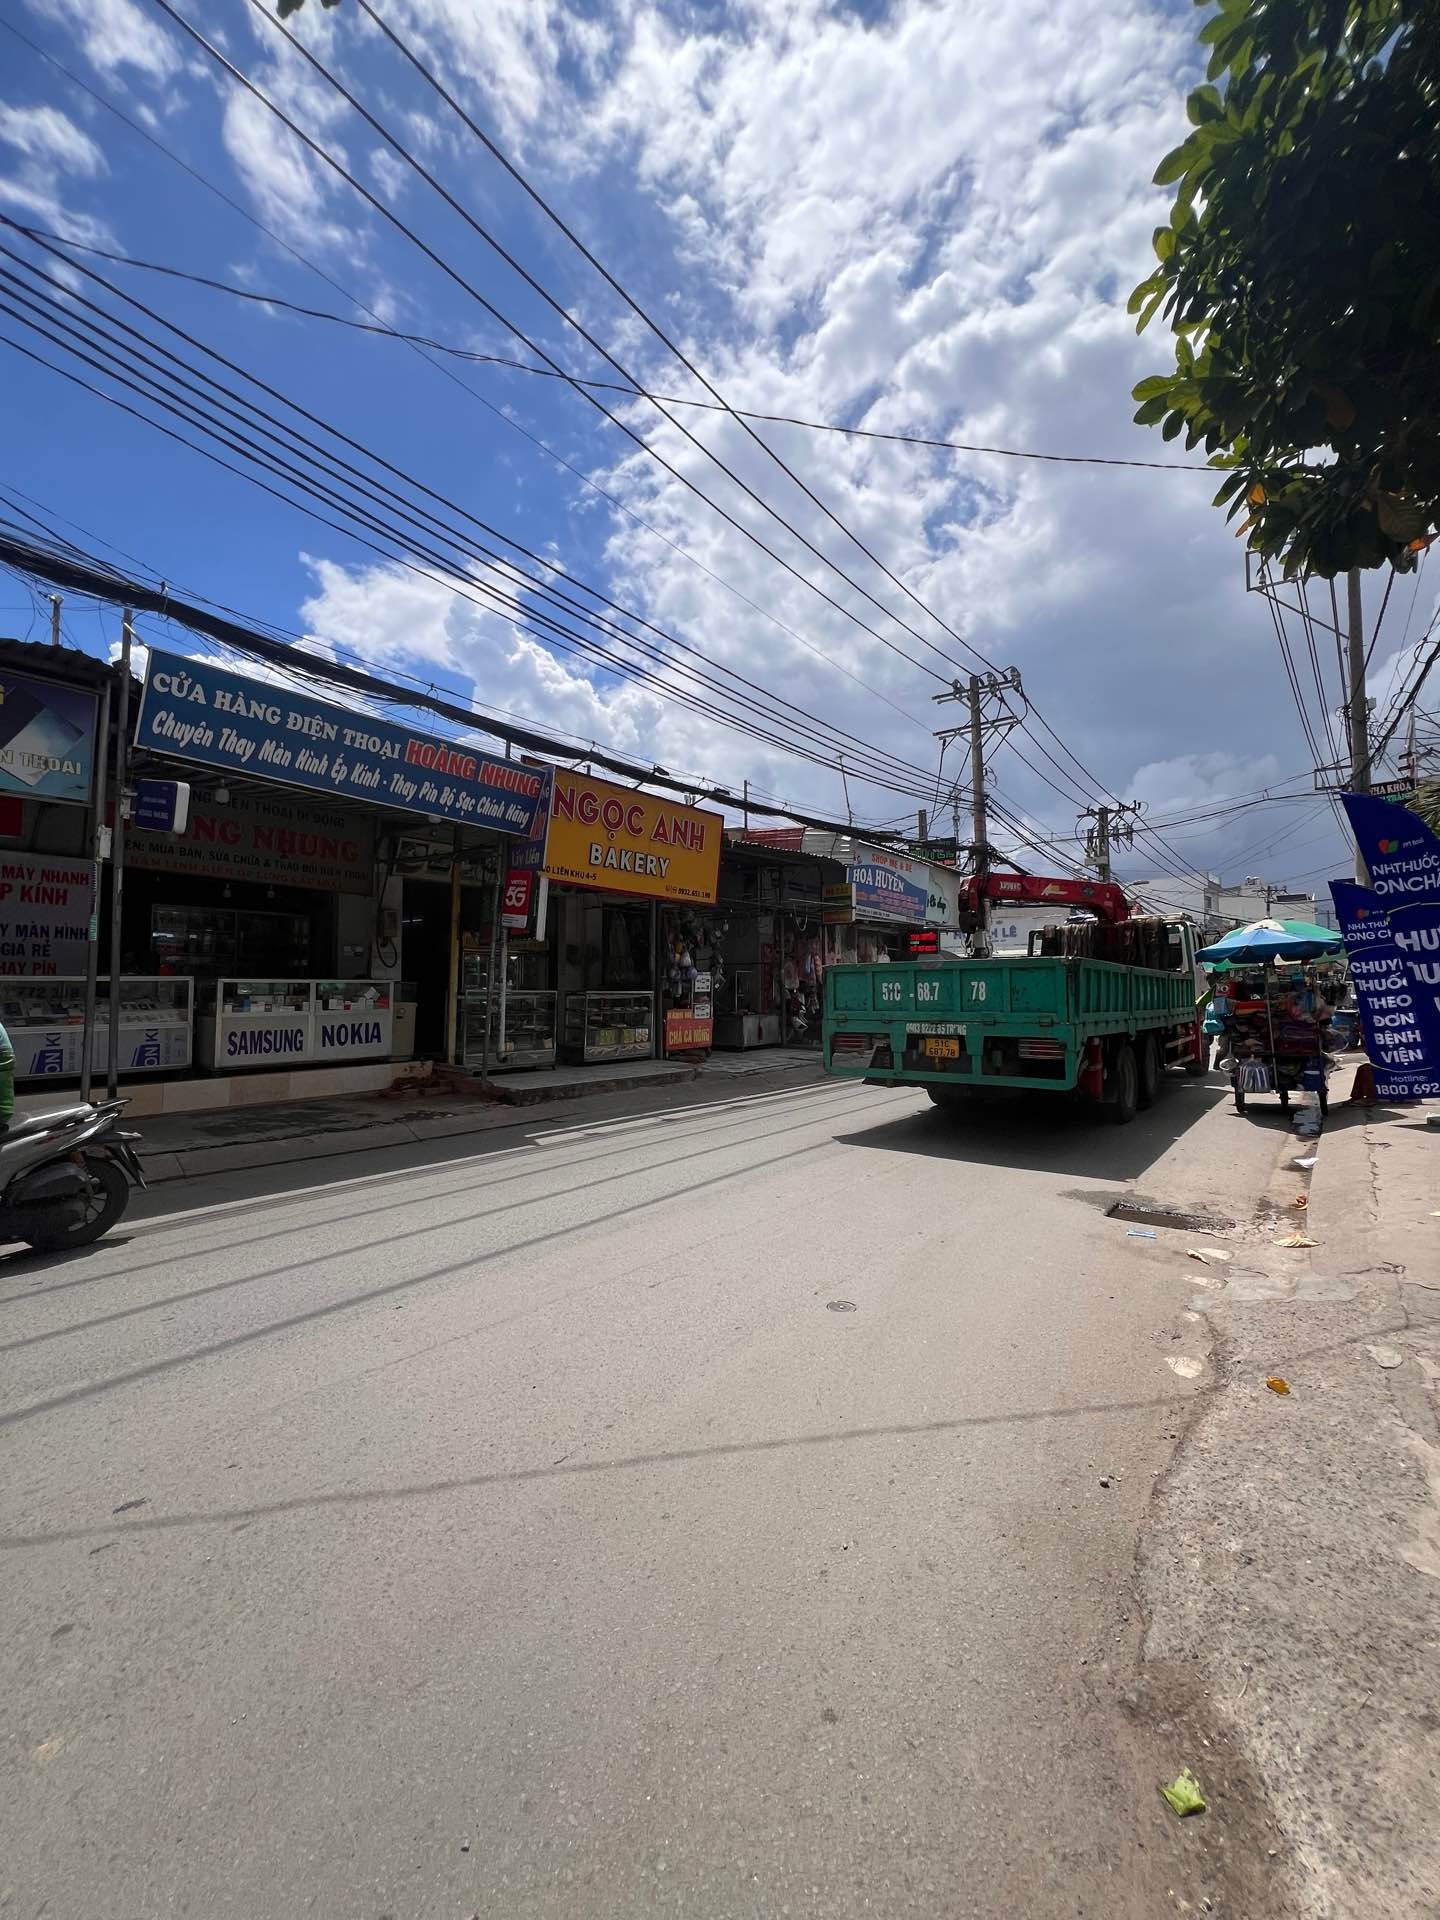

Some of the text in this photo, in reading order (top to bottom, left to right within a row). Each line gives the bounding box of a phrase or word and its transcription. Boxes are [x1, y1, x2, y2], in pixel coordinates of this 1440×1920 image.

[153, 671, 207, 705] CỬA
[213, 690, 282, 725] HÀNG
[286, 712, 340, 741] ĐIỆN
[343, 728, 402, 760] THOẠI
[404, 738, 479, 781] HOÀNG
[478, 760, 542, 799] NHUNG
[152, 710, 214, 749] Chuyên
[218, 727, 257, 764] Thay
[258, 738, 292, 768] Màn
[295, 747, 329, 776] Hình
[350, 762, 380, 789] Kính
[389, 773, 418, 803] Thay
[419, 781, 438, 802] Pin
[439, 786, 457, 813] Bộ
[456, 792, 476, 817] Sạc
[477, 796, 505, 819] Chính
[552, 783, 645, 841] NGỌC
[650, 813, 705, 852] ANH
[148, 842, 174, 855] MUA
[589, 843, 670, 877] BAKERY
[41, 871, 88, 885] NHANH
[552, 866, 570, 878] LIÊN
[570, 867, 585, 879] KHU
[585, 869, 597, 881] 4-5
[853, 868, 873, 886] HOA
[20, 882, 69, 906] KÍNH
[505, 886, 526, 908] 5G
[1002, 925, 1017, 938] LÊ
[882, 982, 901, 1001] 51C
[917, 982, 940, 1001] 68.7
[971, 981, 986, 1001] 78
[1367, 994, 1413, 1009] THEO
[1373, 1012, 1415, 1027] ĐƠN
[227, 1028, 304, 1056] SAMSUNG
[321, 1022, 382, 1048] NOKIA
[934, 1039, 949, 1048] 51C
[1374, 1030, 1421, 1048] BỆNH
[1381, 1046, 1423, 1066] VIỆN
[1376, 1084, 1409, 1095] 1800
